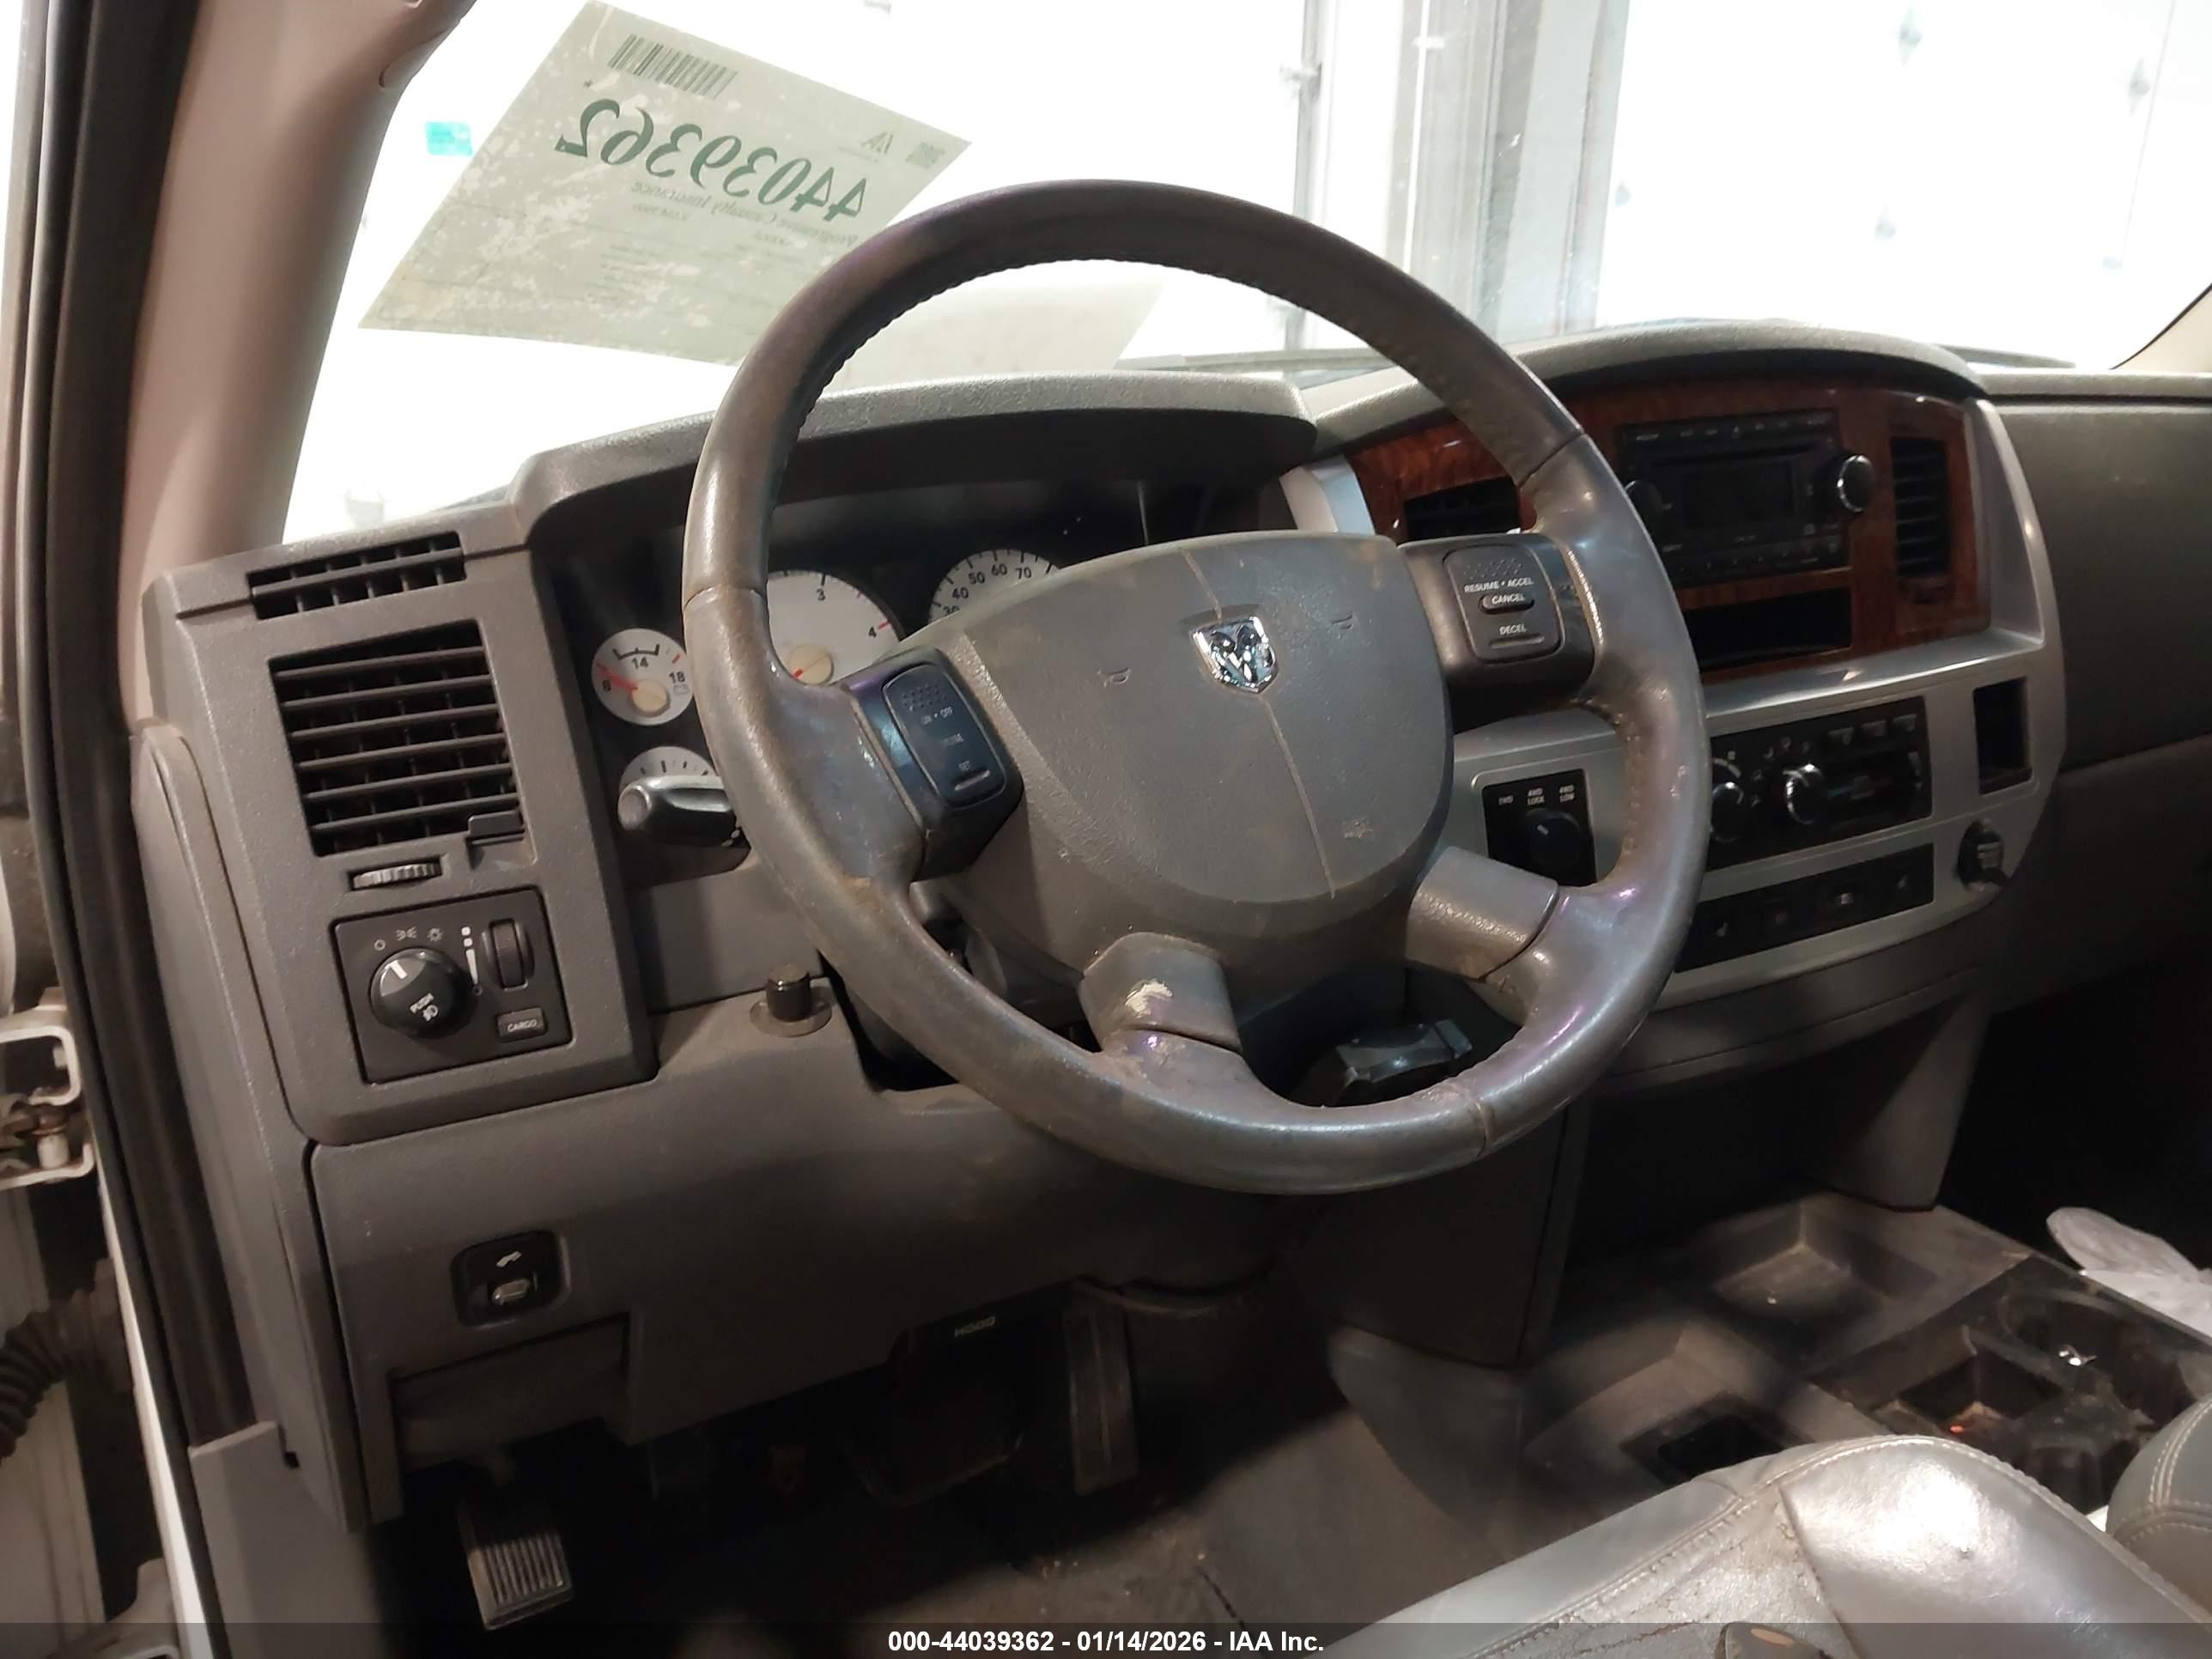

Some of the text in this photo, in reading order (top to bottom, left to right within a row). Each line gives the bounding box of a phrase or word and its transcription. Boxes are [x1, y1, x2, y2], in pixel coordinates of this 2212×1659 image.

[991, 563, 1008, 576] 60
[1015, 567, 1032, 580] 70
[968, 571, 986, 585] 50
[1463, 576, 1534, 593] RESUME ACCEL
[817, 588, 826, 602] 3
[951, 587, 969, 600] 40
[1491, 592, 1525, 605] CANCEL
[868, 626, 877, 639] 4
[1498, 623, 1527, 635] DECEL
[631, 657, 649, 670] 14
[669, 672, 686, 684] 18
[507, 1018, 538, 1033] CARGO
